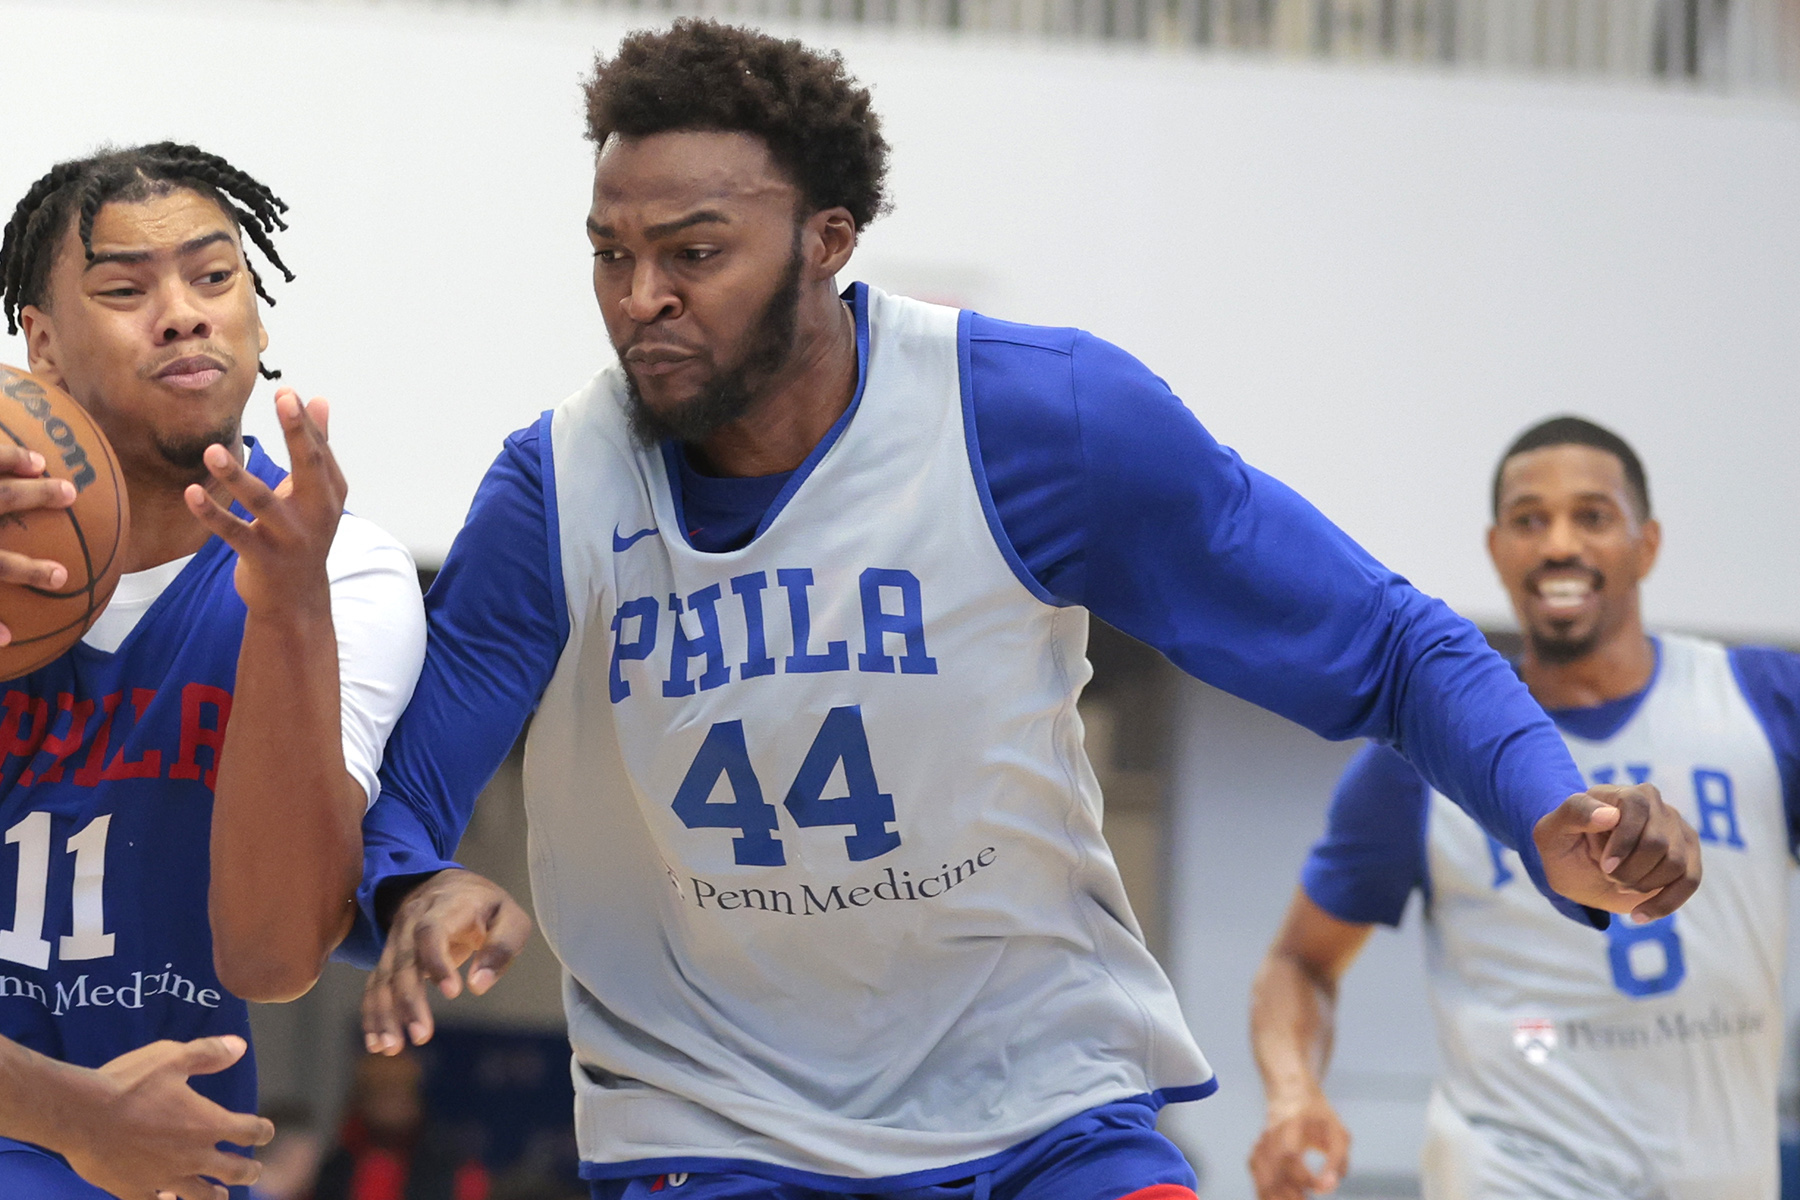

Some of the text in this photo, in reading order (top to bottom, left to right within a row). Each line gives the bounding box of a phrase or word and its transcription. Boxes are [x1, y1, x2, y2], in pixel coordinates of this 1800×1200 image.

[609, 566, 938, 704] PHILA
[671, 704, 902, 867] 44
[690, 846, 998, 916] Penn Medicine
[51, 962, 221, 1016] Medcine
